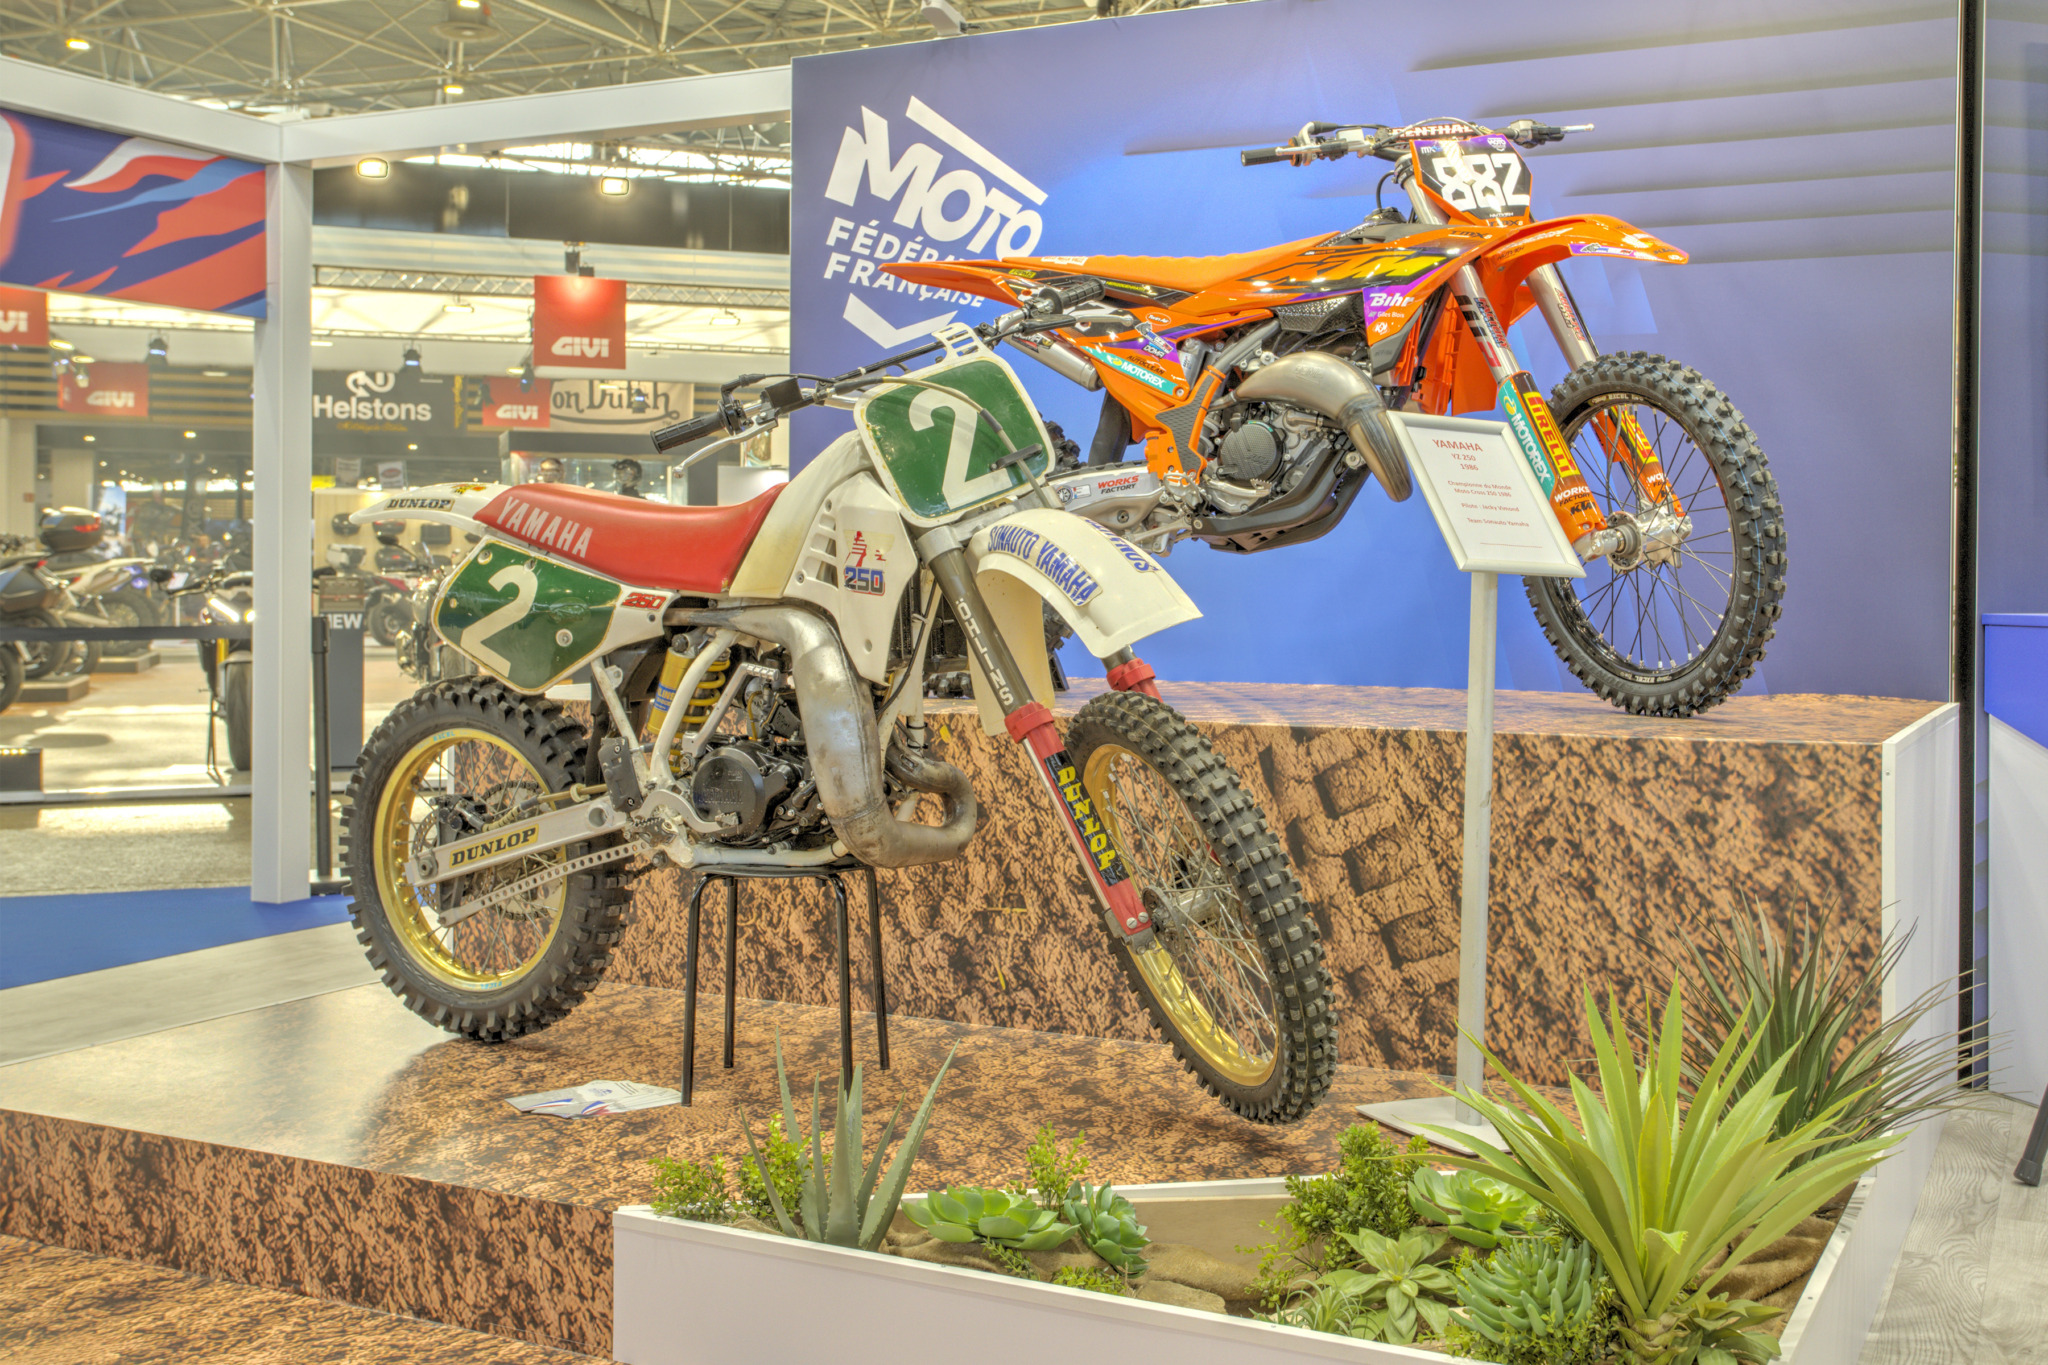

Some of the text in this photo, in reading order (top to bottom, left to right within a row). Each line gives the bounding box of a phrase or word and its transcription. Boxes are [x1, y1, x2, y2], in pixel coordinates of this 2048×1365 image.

[824, 105, 1043, 262] MOTO
[1432, 153, 1530, 211] 882
[823, 252, 986, 309] FRANÇAISE
[1369, 292, 1414, 308] Bihr
[0, 310, 28, 332] VI
[551, 336, 610, 358] GIVI
[1121, 362, 1165, 388] MOTOREX
[86, 390, 135, 408] GIVI
[312, 394, 432, 421] Helstons
[495, 404, 539, 420] GIVI
[1432, 439, 1484, 452] YAMAHA
[1528, 395, 1577, 474] PIRELLI
[908, 387, 1012, 510] 2
[1451, 453, 1461, 461] YZ
[1511, 413, 1551, 483] MOTOREX
[1460, 463, 1479, 471] 1986
[1098, 475, 1139, 490] WORKS
[1101, 483, 1136, 495] FACTORY
[1554, 486, 1590, 503] WORKS
[386, 498, 451, 510] DUNLOP
[1559, 493, 1591, 507] FACTORY
[1570, 501, 1597, 516] KTM
[496, 496, 594, 559] YAMAHA
[987, 525, 1100, 606] SONAUTO YAMAHA
[844, 566, 885, 595] 250
[460, 564, 539, 678] 2
[1057, 765, 1118, 873] DUNLOP
[451, 827, 536, 867] DUNLOP
